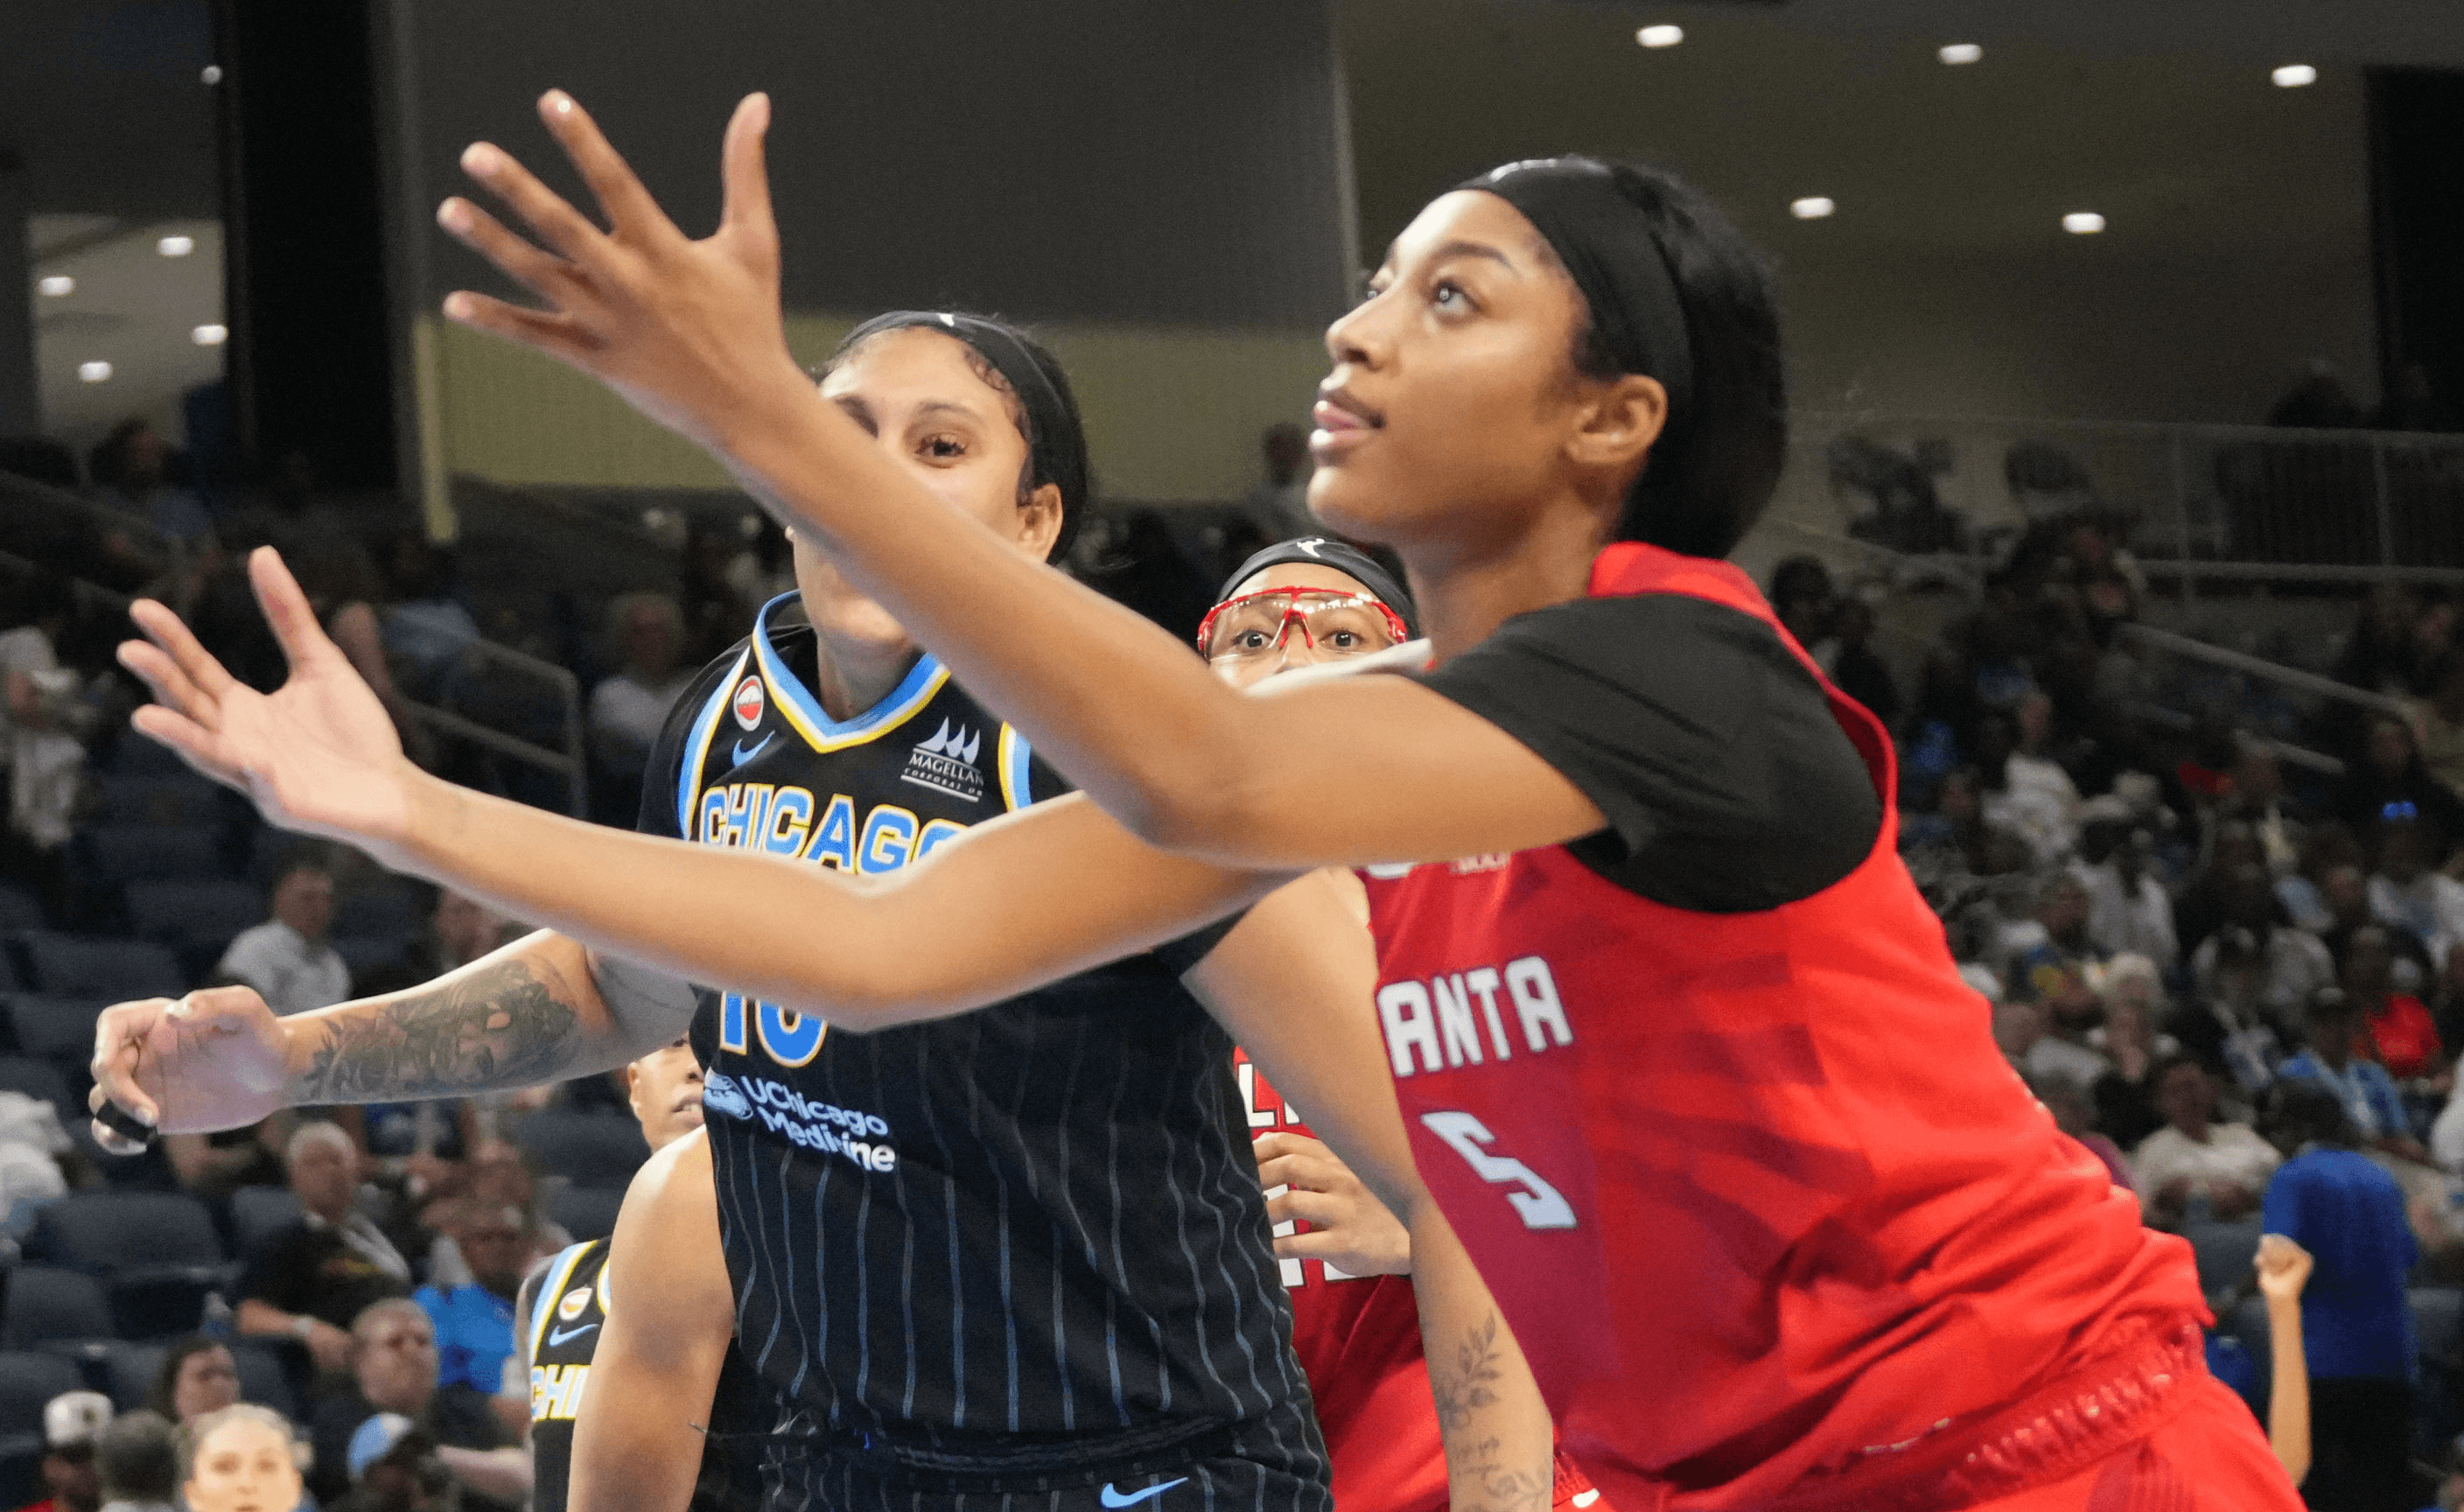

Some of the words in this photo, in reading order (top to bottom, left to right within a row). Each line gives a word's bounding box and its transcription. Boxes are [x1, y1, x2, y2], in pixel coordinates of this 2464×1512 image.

[908, 752, 984, 787] MAGELLAN
[740, 1074, 889, 1137] UChicago
[1420, 1110, 1578, 1229] 5
